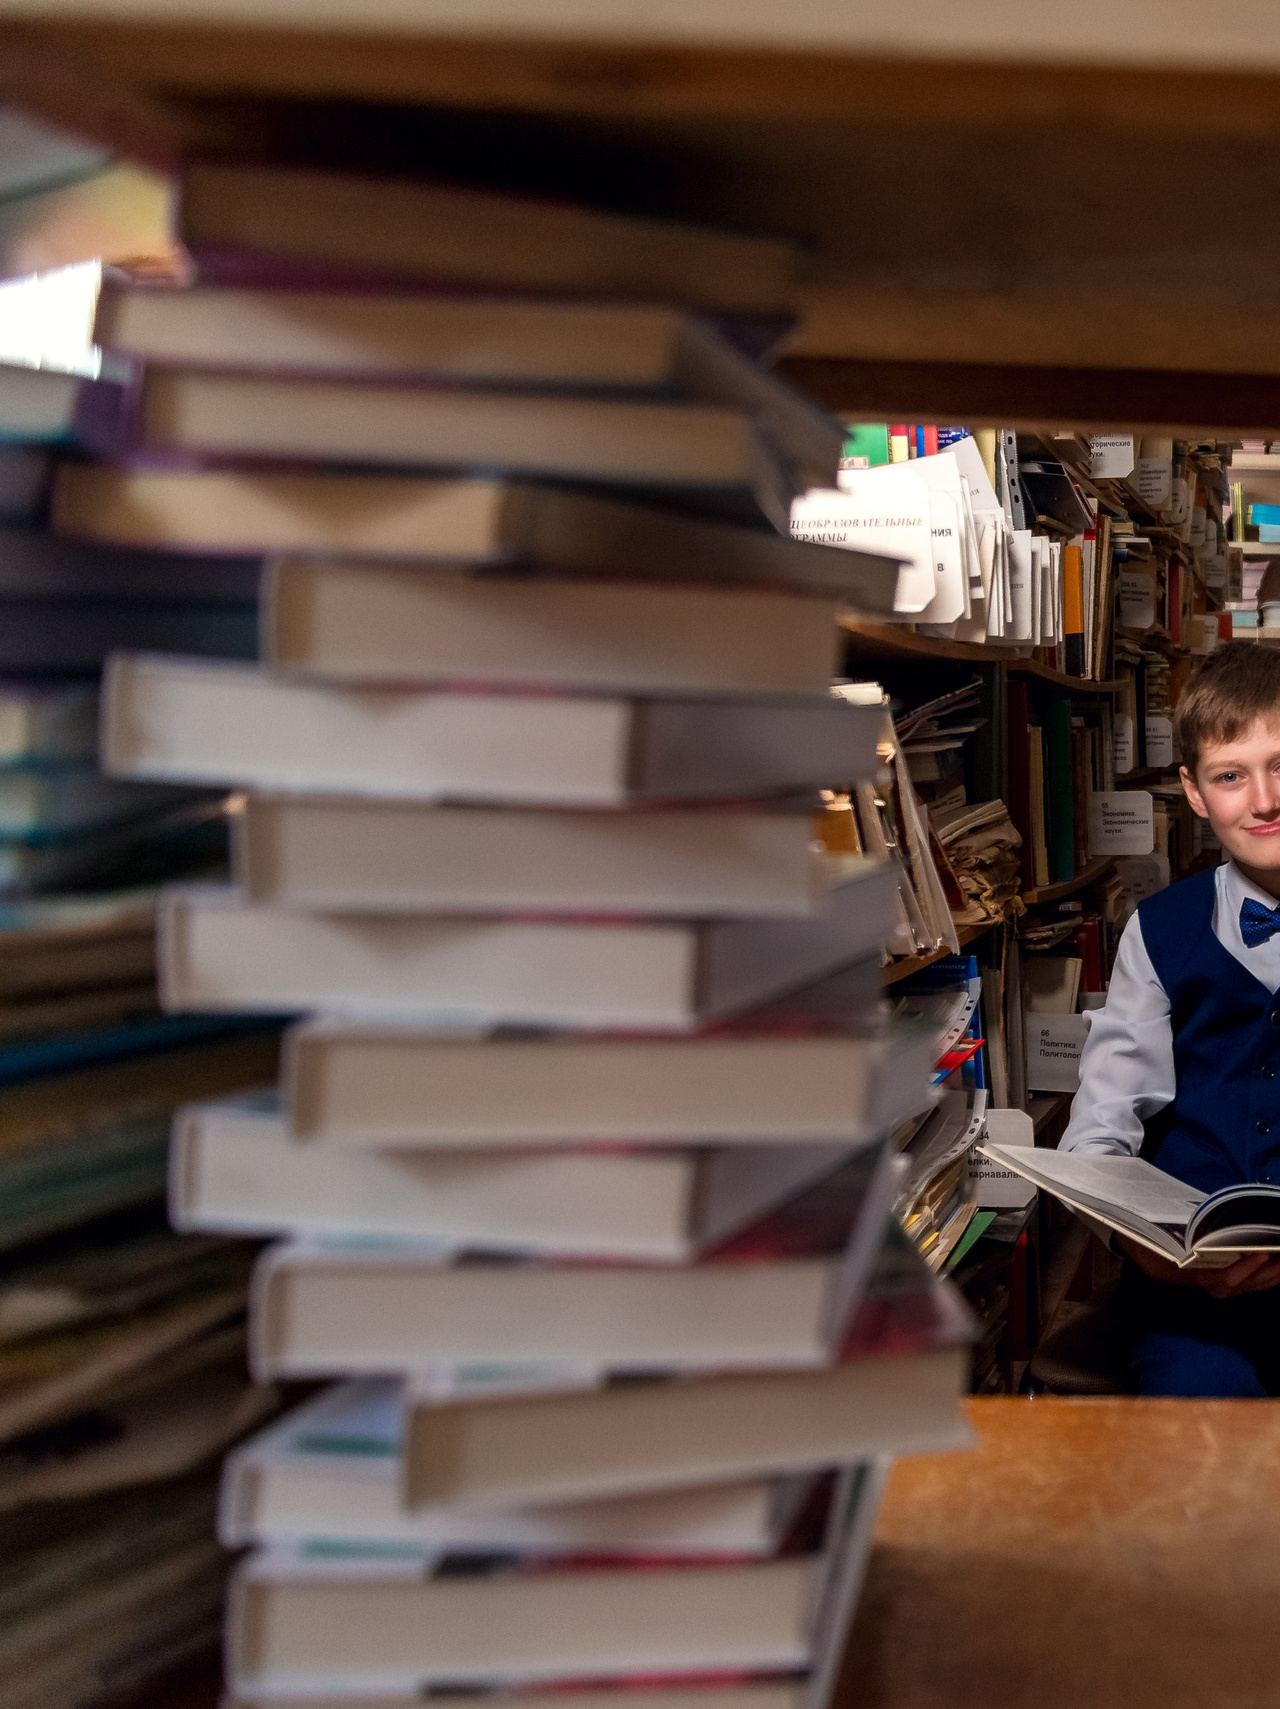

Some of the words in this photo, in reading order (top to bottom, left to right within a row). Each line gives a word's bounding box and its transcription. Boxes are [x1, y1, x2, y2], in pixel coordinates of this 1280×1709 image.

[1040, 1029, 1050, 1037] 66
[1040, 1039, 1078, 1049] Политика.
[967, 1156, 993, 1168] ёлки,
